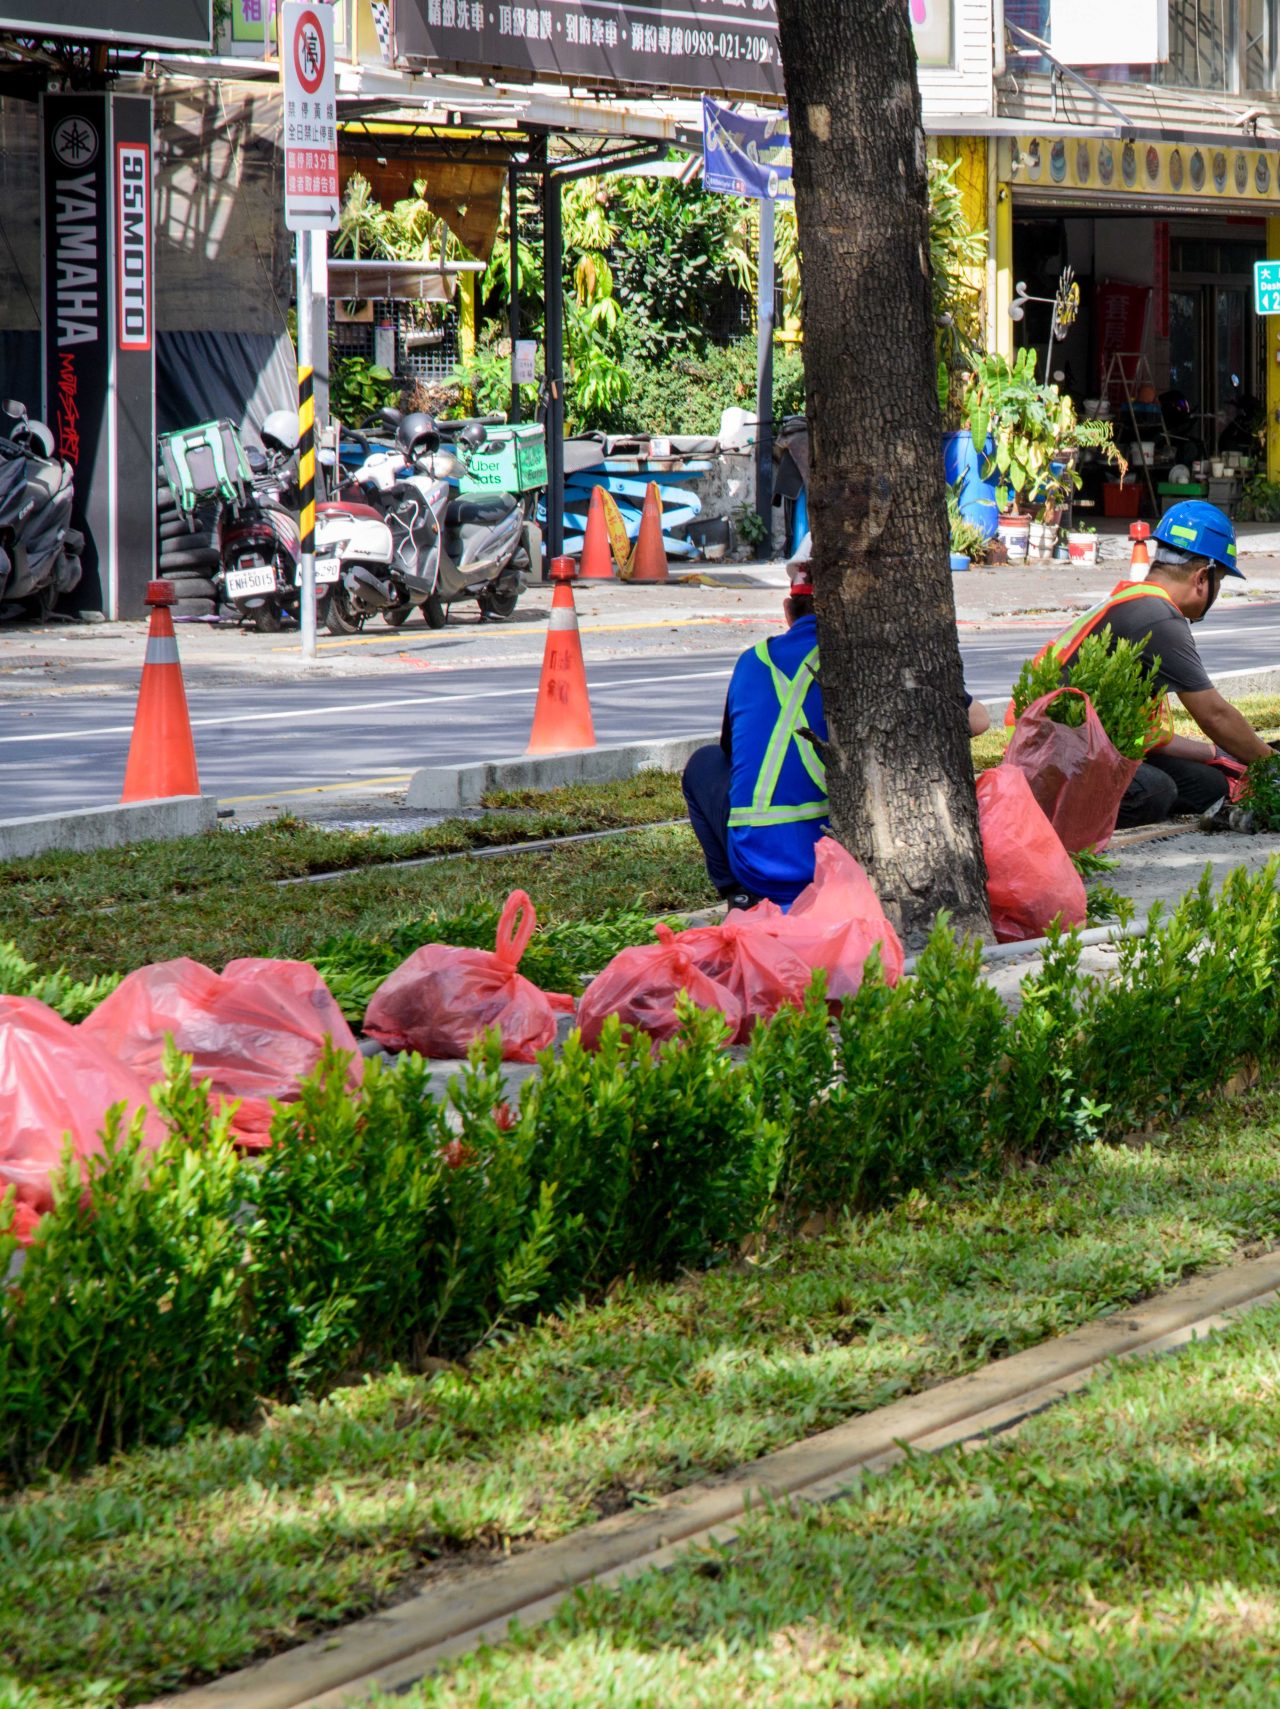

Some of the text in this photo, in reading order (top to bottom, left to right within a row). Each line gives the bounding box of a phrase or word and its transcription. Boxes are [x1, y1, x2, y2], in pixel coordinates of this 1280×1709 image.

[288, 124, 335, 142] 全日禁止停車
[56, 172, 98, 347] YAMAHA
[122, 156, 145, 336] 95MOTO
[471, 460, 500, 472] Uber
